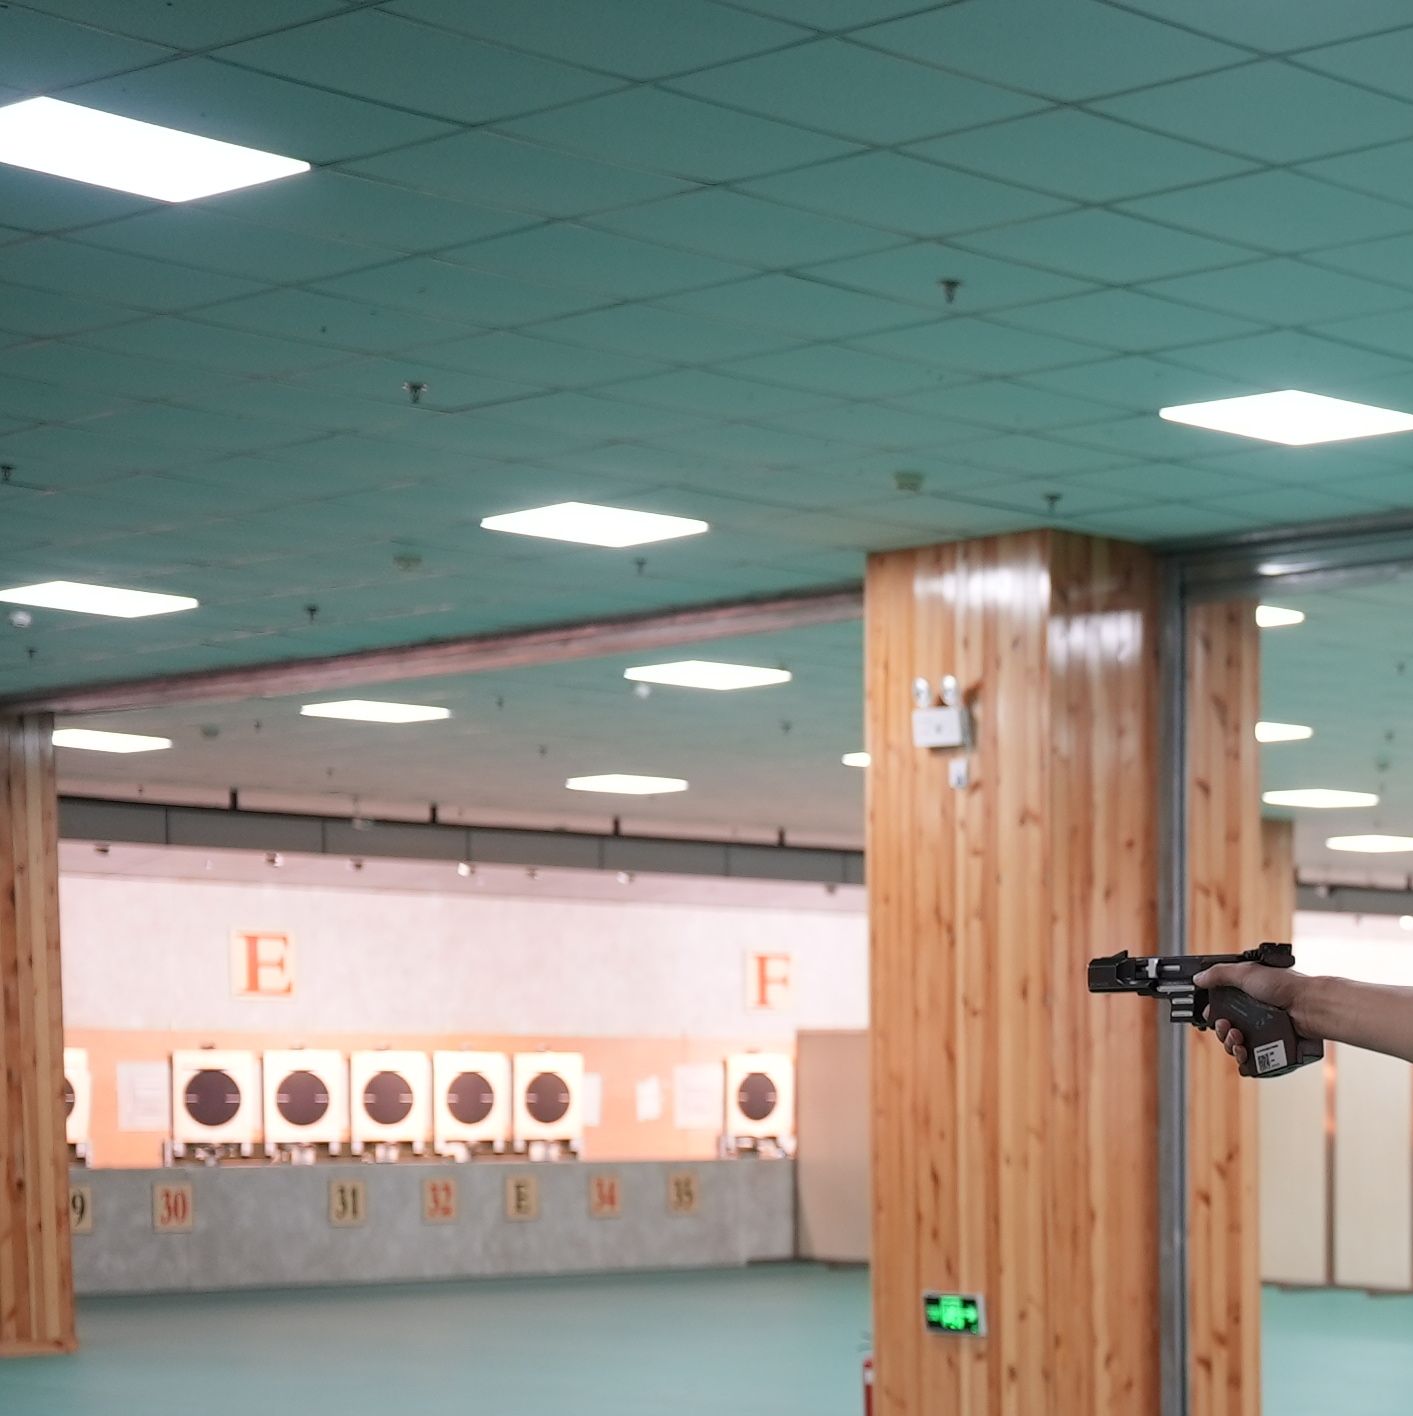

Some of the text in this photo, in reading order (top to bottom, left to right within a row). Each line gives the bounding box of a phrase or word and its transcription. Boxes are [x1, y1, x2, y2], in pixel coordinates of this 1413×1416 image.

[239, 933, 292, 996] E
[754, 952, 790, 1008] F
[72, 1189, 86, 1226] 9
[160, 1188, 188, 1225] 30
[335, 1184, 360, 1220] 31
